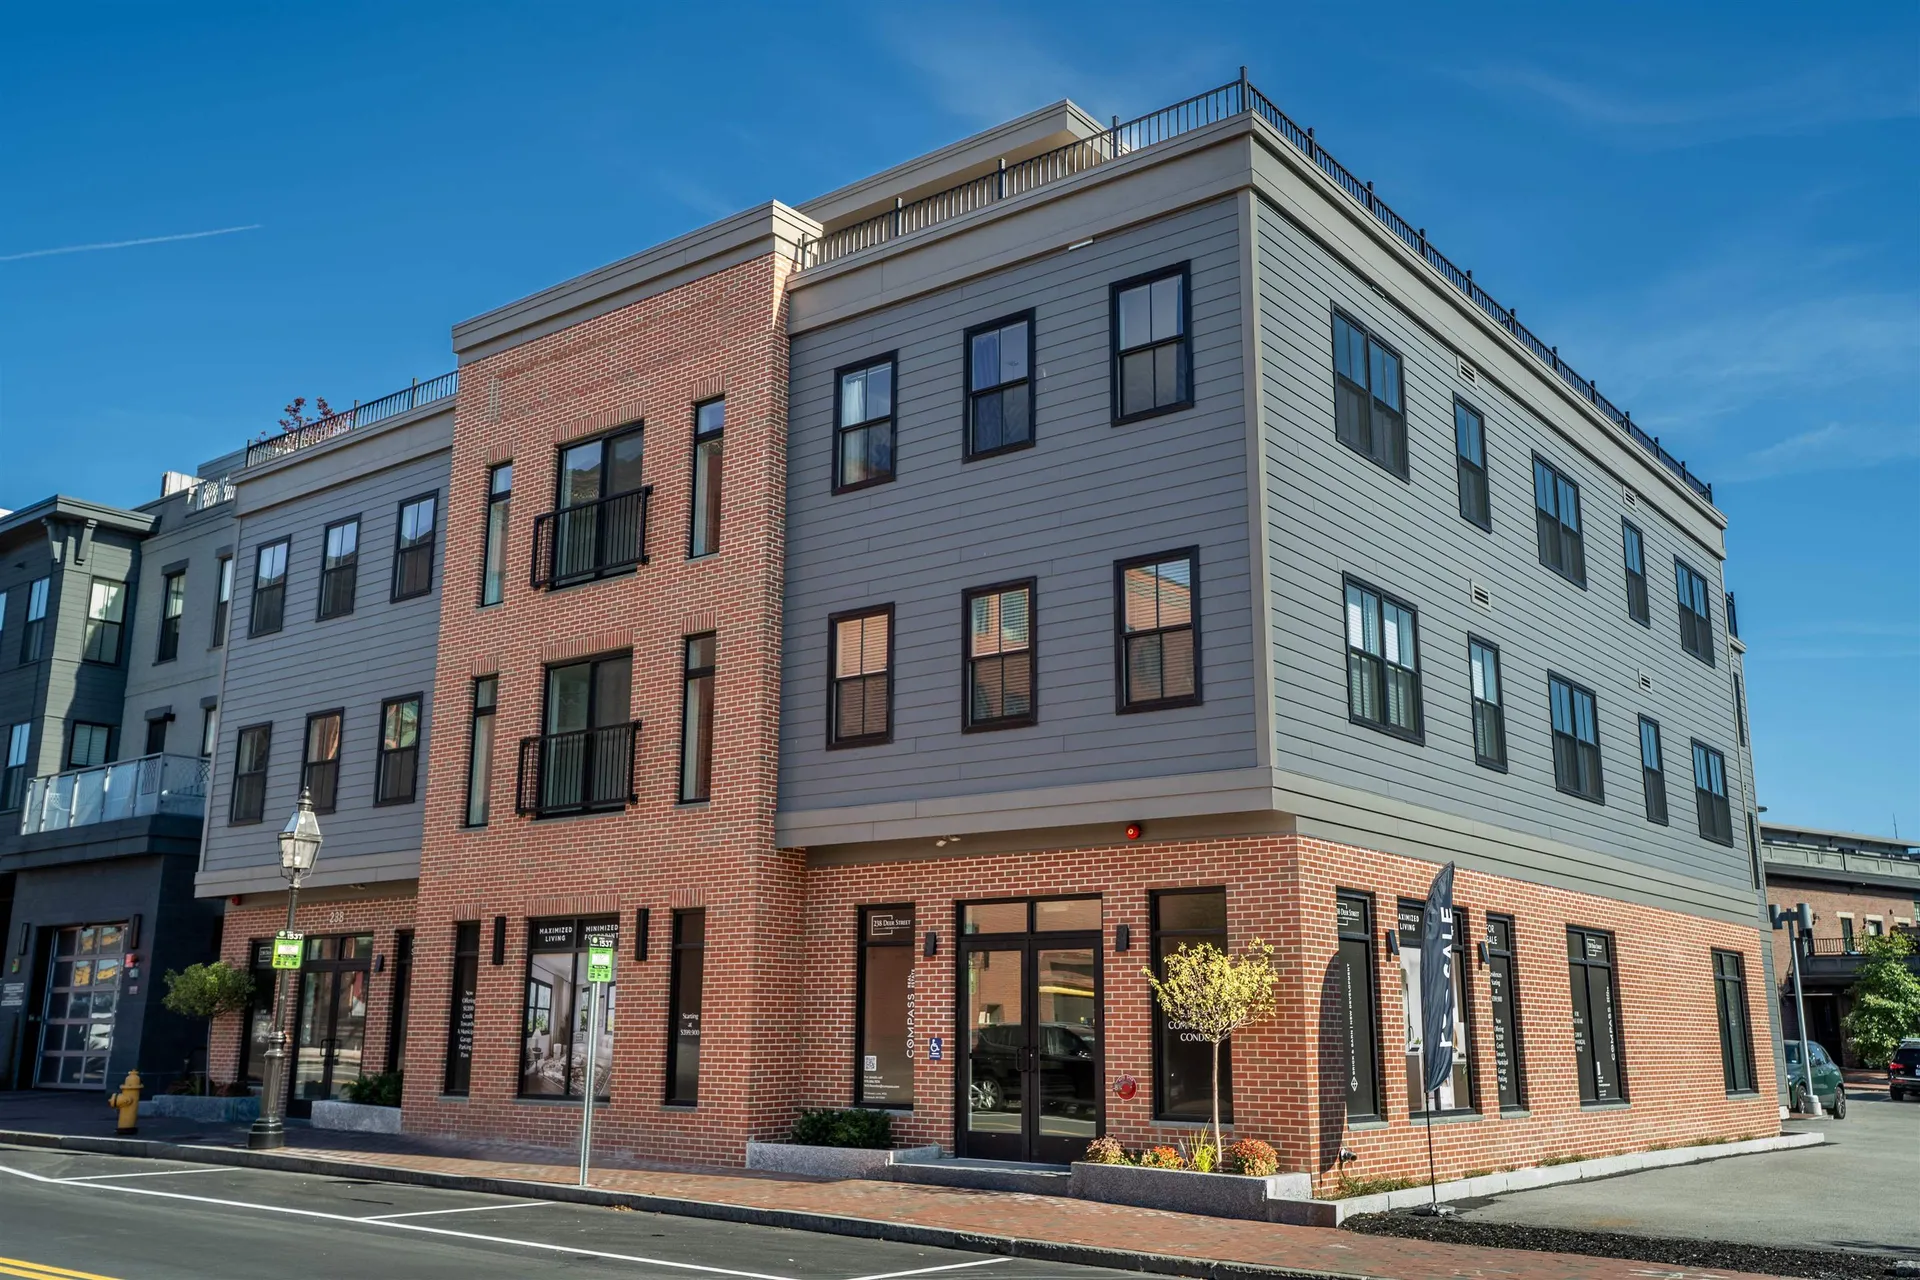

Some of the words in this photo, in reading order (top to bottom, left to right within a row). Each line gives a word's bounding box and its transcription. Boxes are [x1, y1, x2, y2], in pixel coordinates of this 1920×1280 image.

[330, 912, 344, 922] 238
[1398, 913, 1420, 922] AXIMIZED
[1400, 923, 1415, 932] LIVING
[906, 993, 915, 1058] COMPASS
[1607, 1007, 1615, 1061] COMPASS
